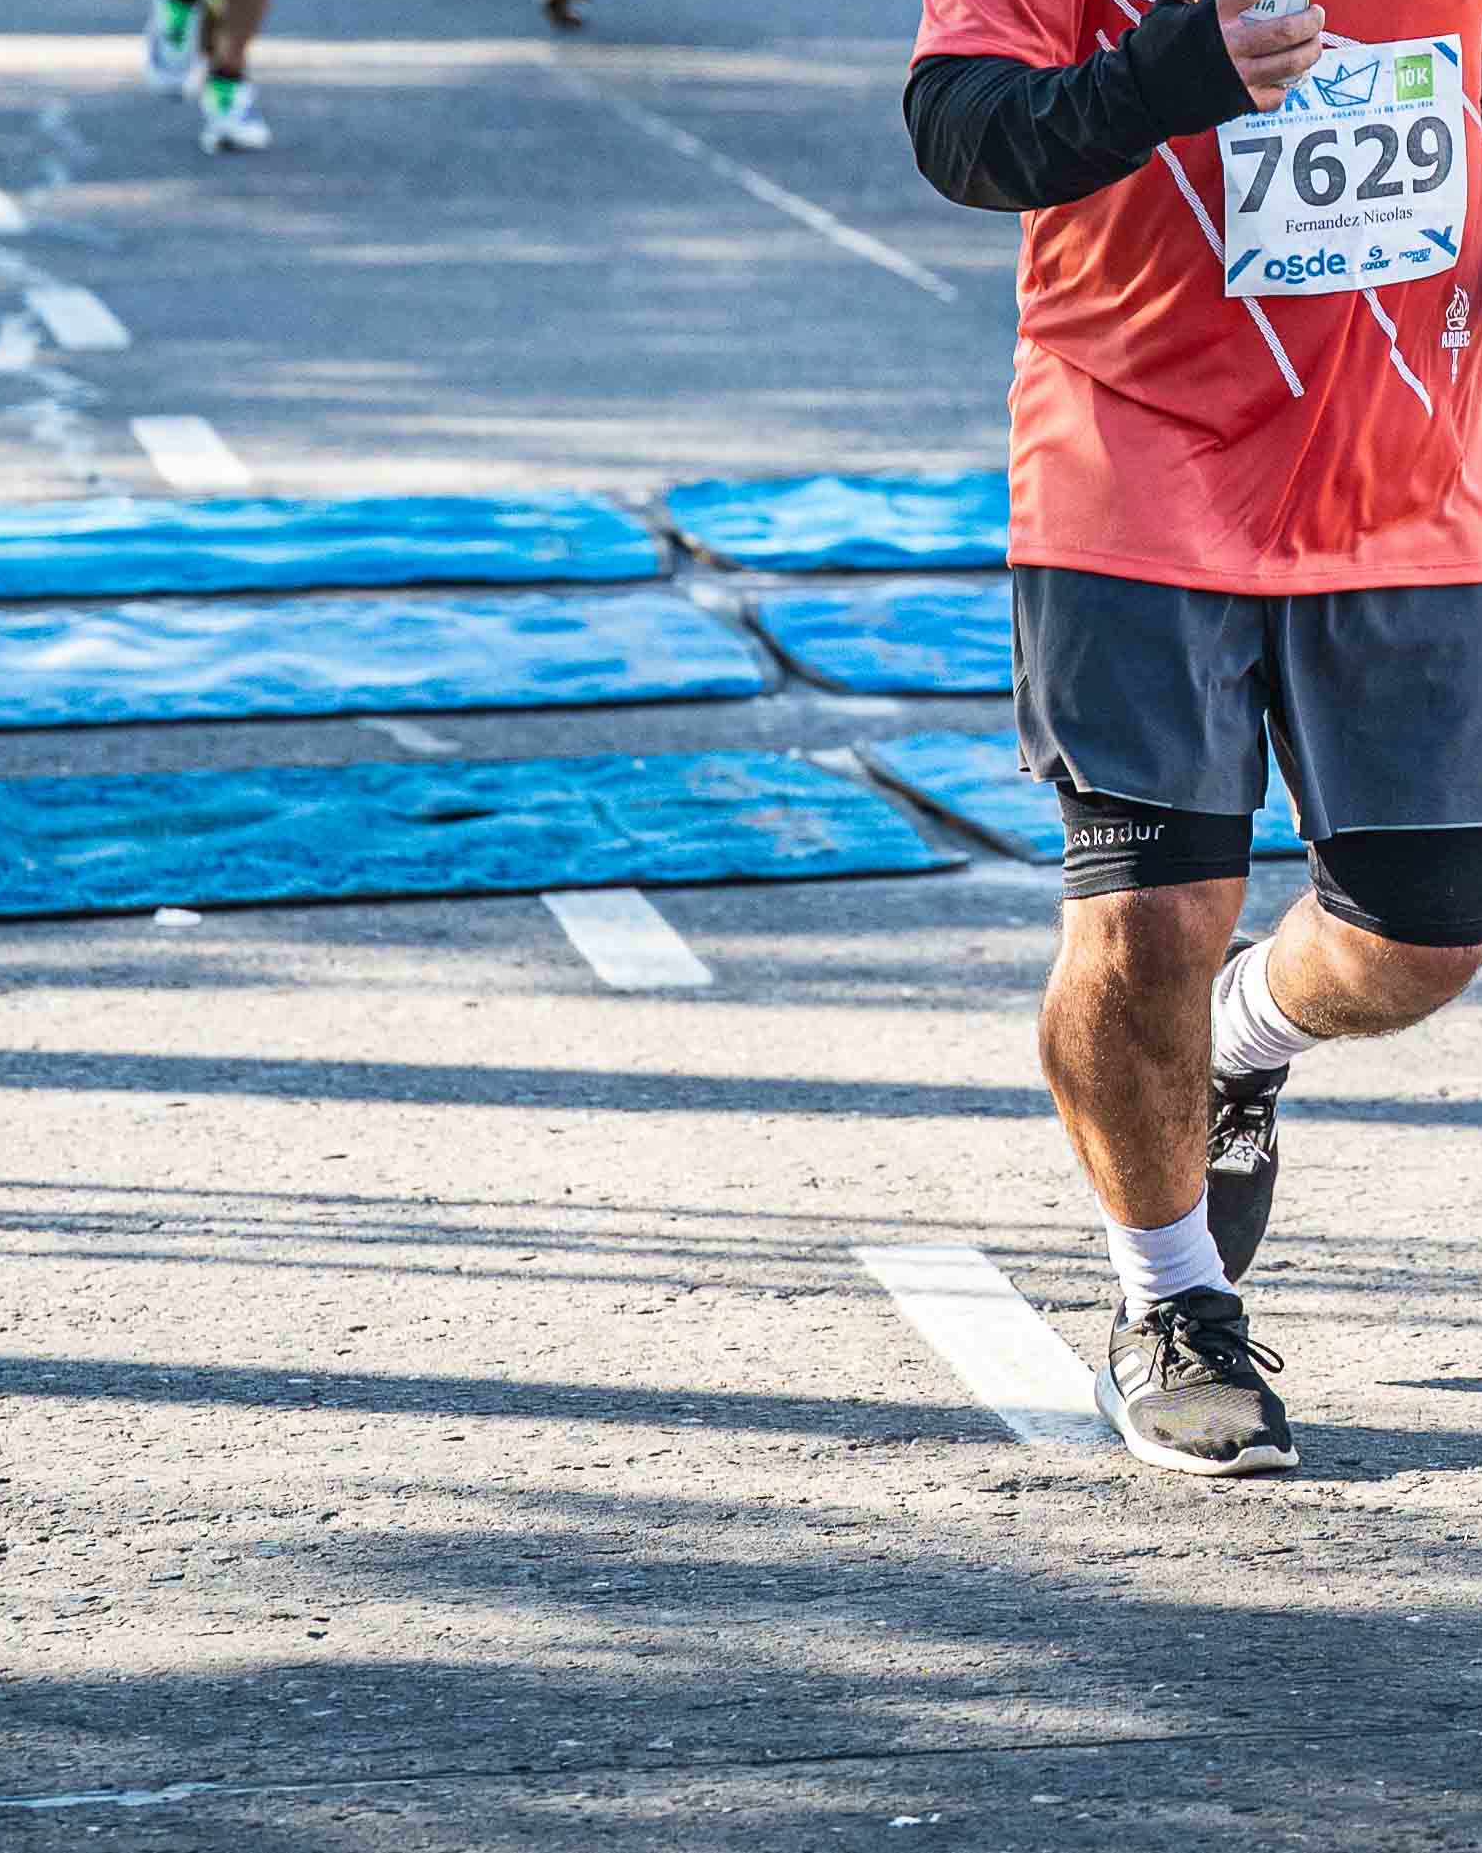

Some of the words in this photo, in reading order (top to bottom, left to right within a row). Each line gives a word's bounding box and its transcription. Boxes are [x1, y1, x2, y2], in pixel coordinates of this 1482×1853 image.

[1230, 116, 1453, 213] 7629
[1285, 213, 1360, 234] Fernandez
[1364, 206, 1413, 224] Nicolas
[1264, 248, 1346, 282] osde
